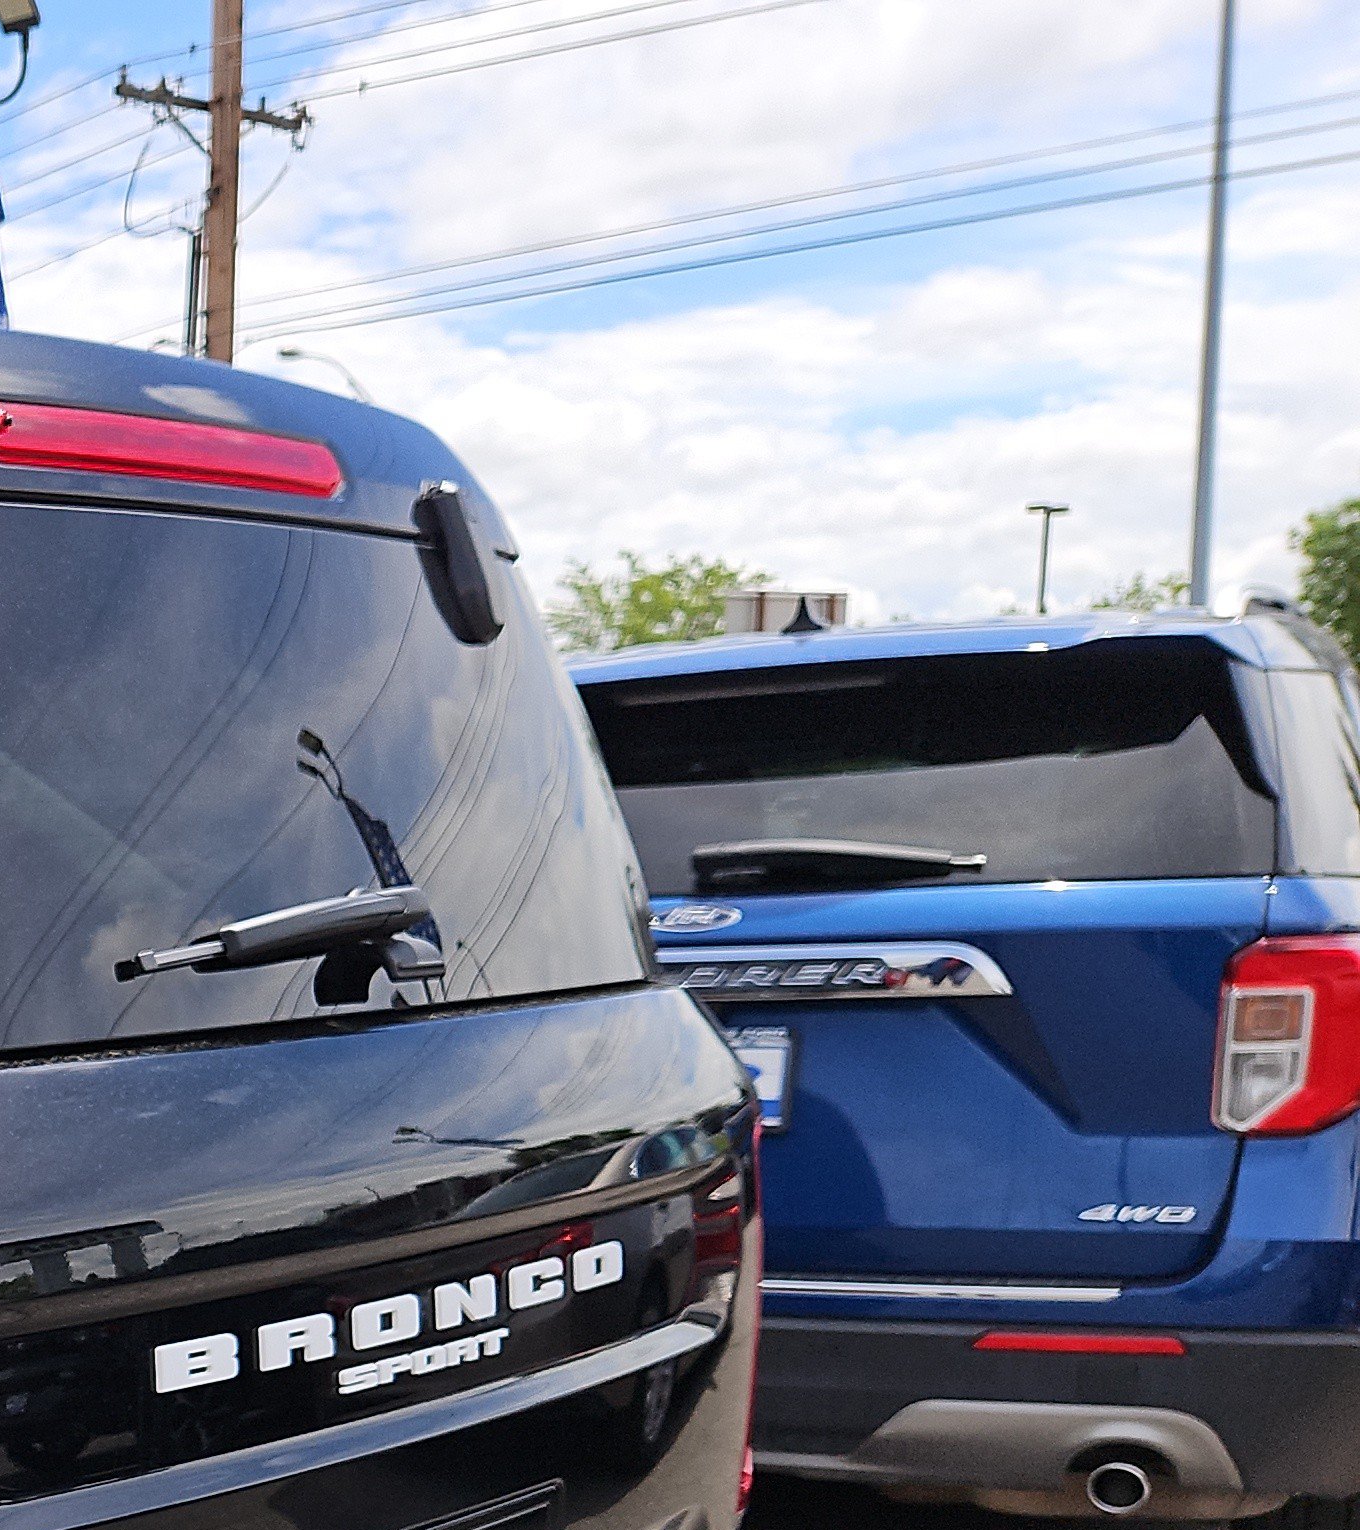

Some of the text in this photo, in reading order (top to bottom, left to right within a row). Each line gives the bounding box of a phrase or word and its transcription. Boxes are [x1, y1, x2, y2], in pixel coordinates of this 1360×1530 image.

[1077, 1203, 1197, 1223] 4WD
[154, 1240, 624, 1393] BRONCO
[338, 1328, 509, 1394] SPORT
